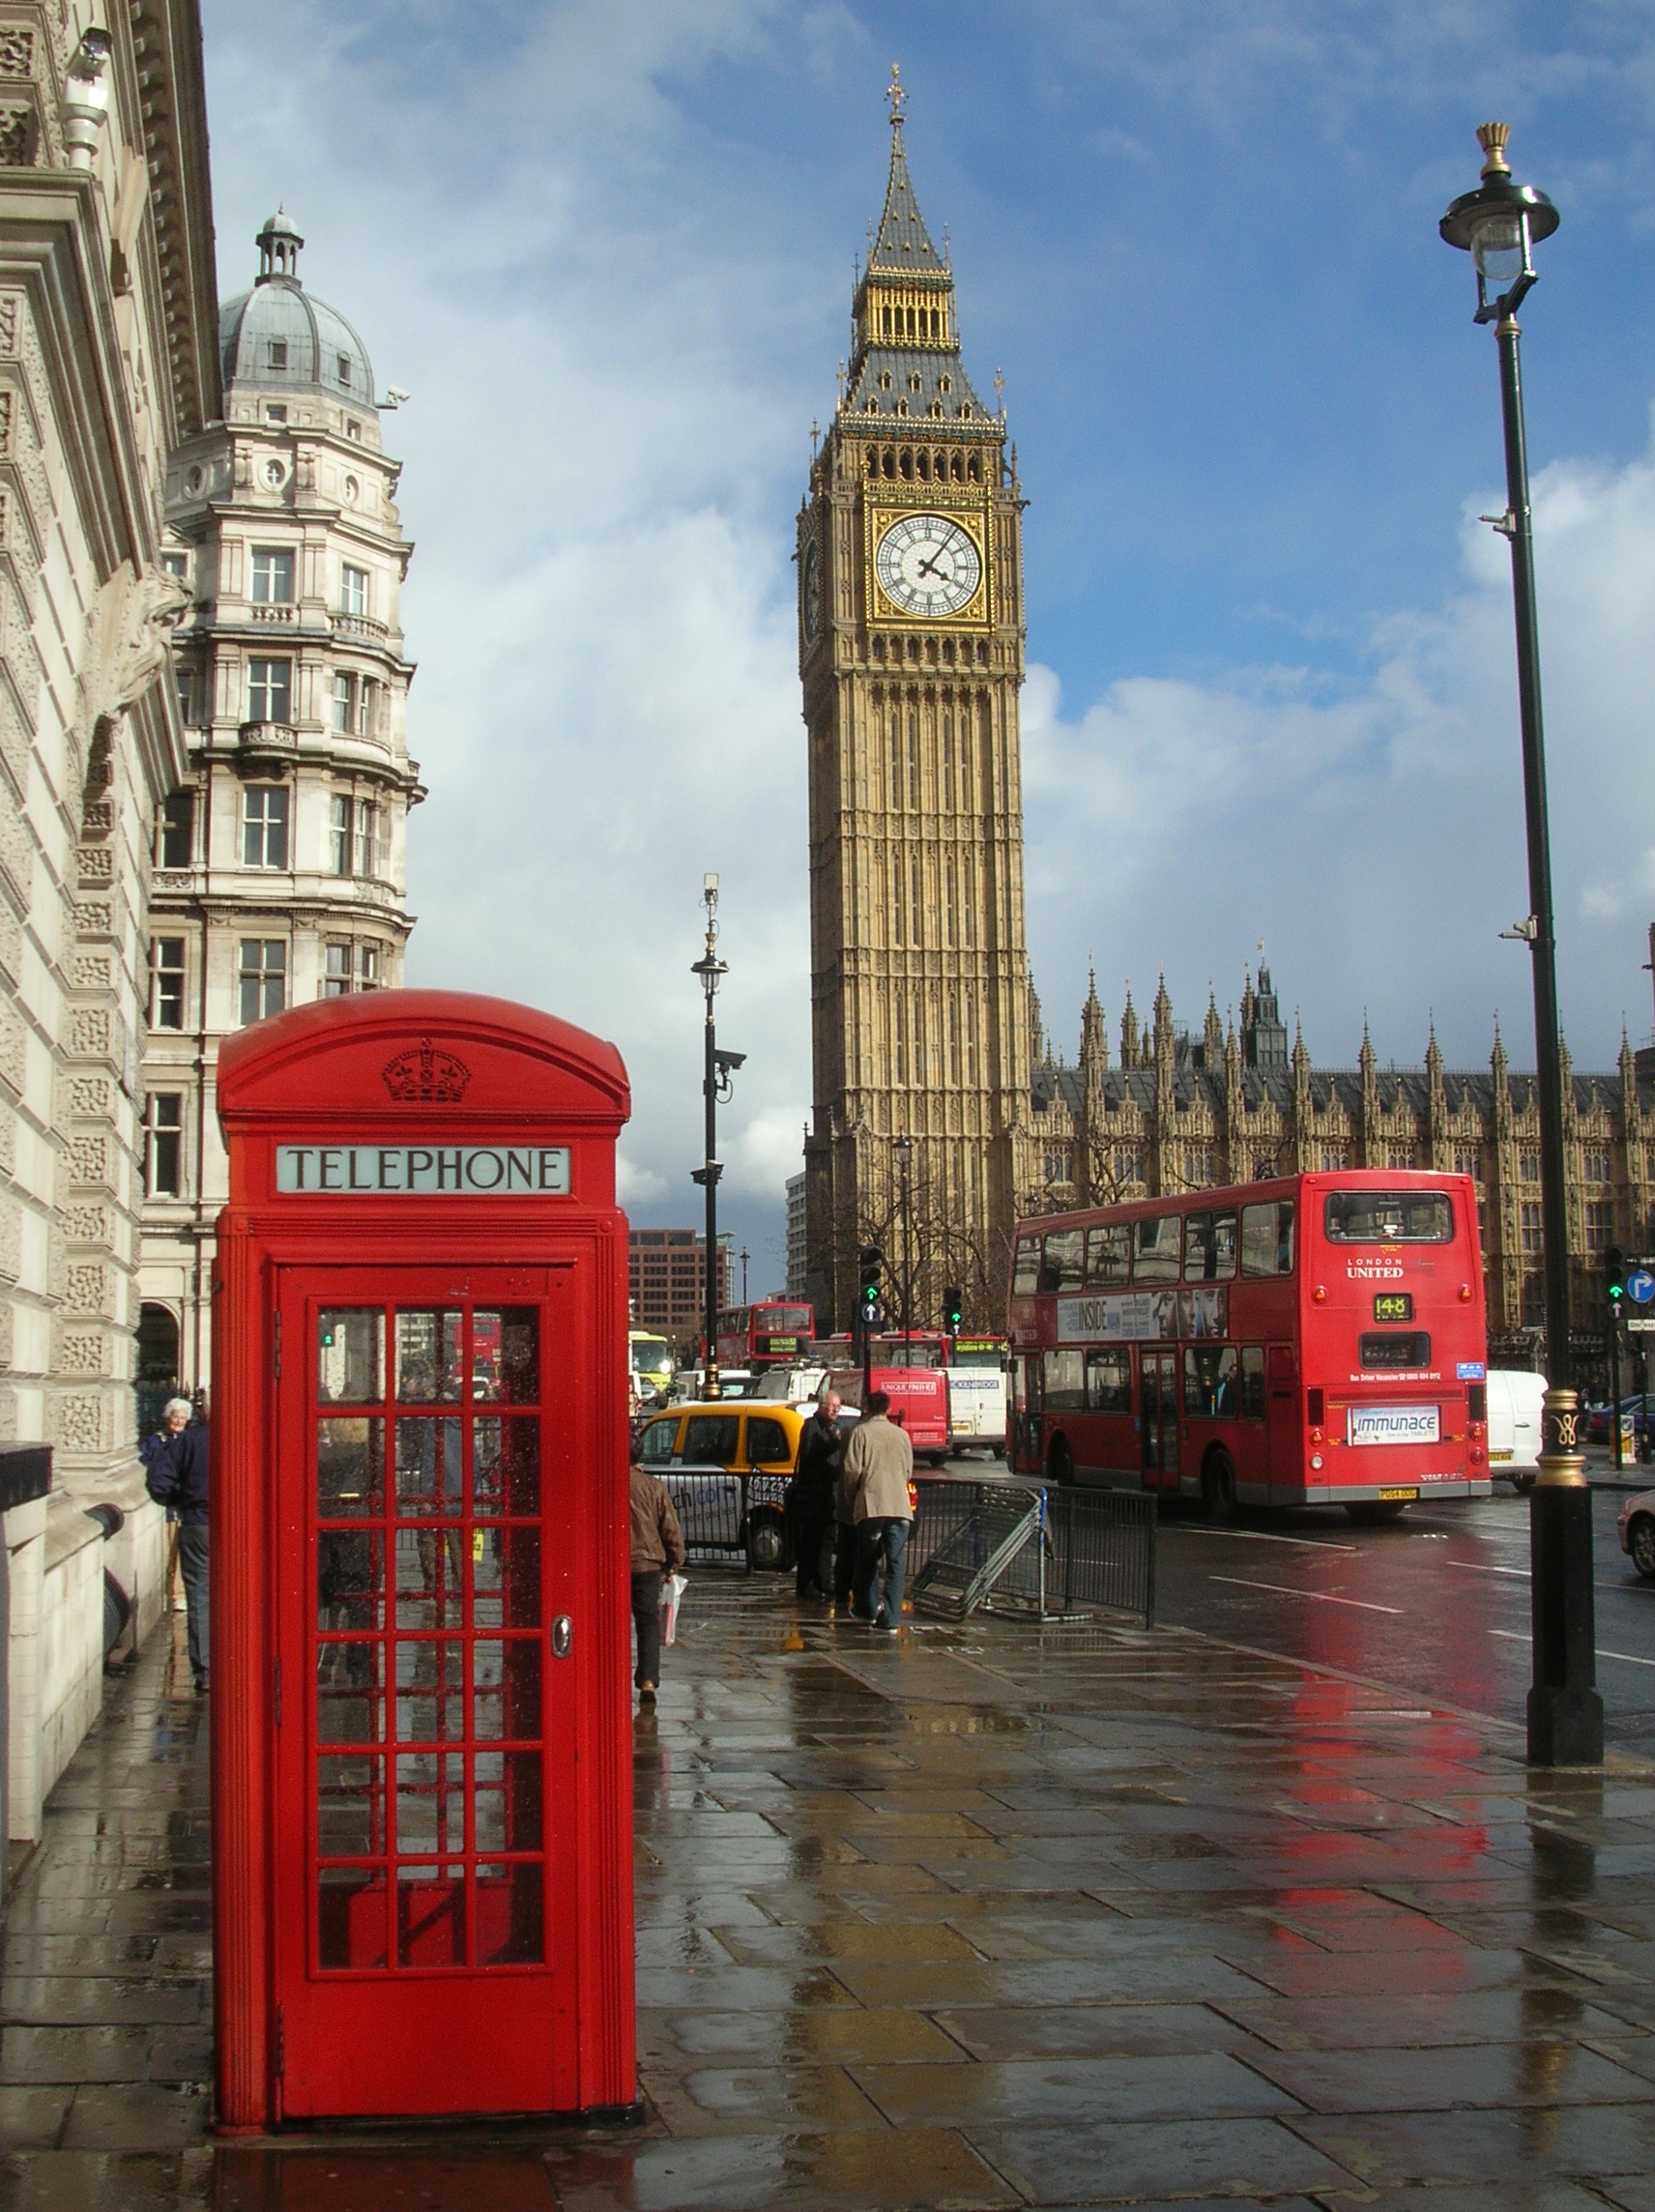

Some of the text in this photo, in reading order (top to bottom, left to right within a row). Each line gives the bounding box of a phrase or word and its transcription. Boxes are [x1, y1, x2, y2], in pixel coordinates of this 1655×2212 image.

[287, 1150, 562, 1189] TELEPHONE
[1347, 1267, 1404, 1279] UNITED
[1377, 1298, 1405, 1314] 148
[1078, 1300, 1107, 1331] INSIDE
[882, 1382, 906, 1392] UNIQUE
